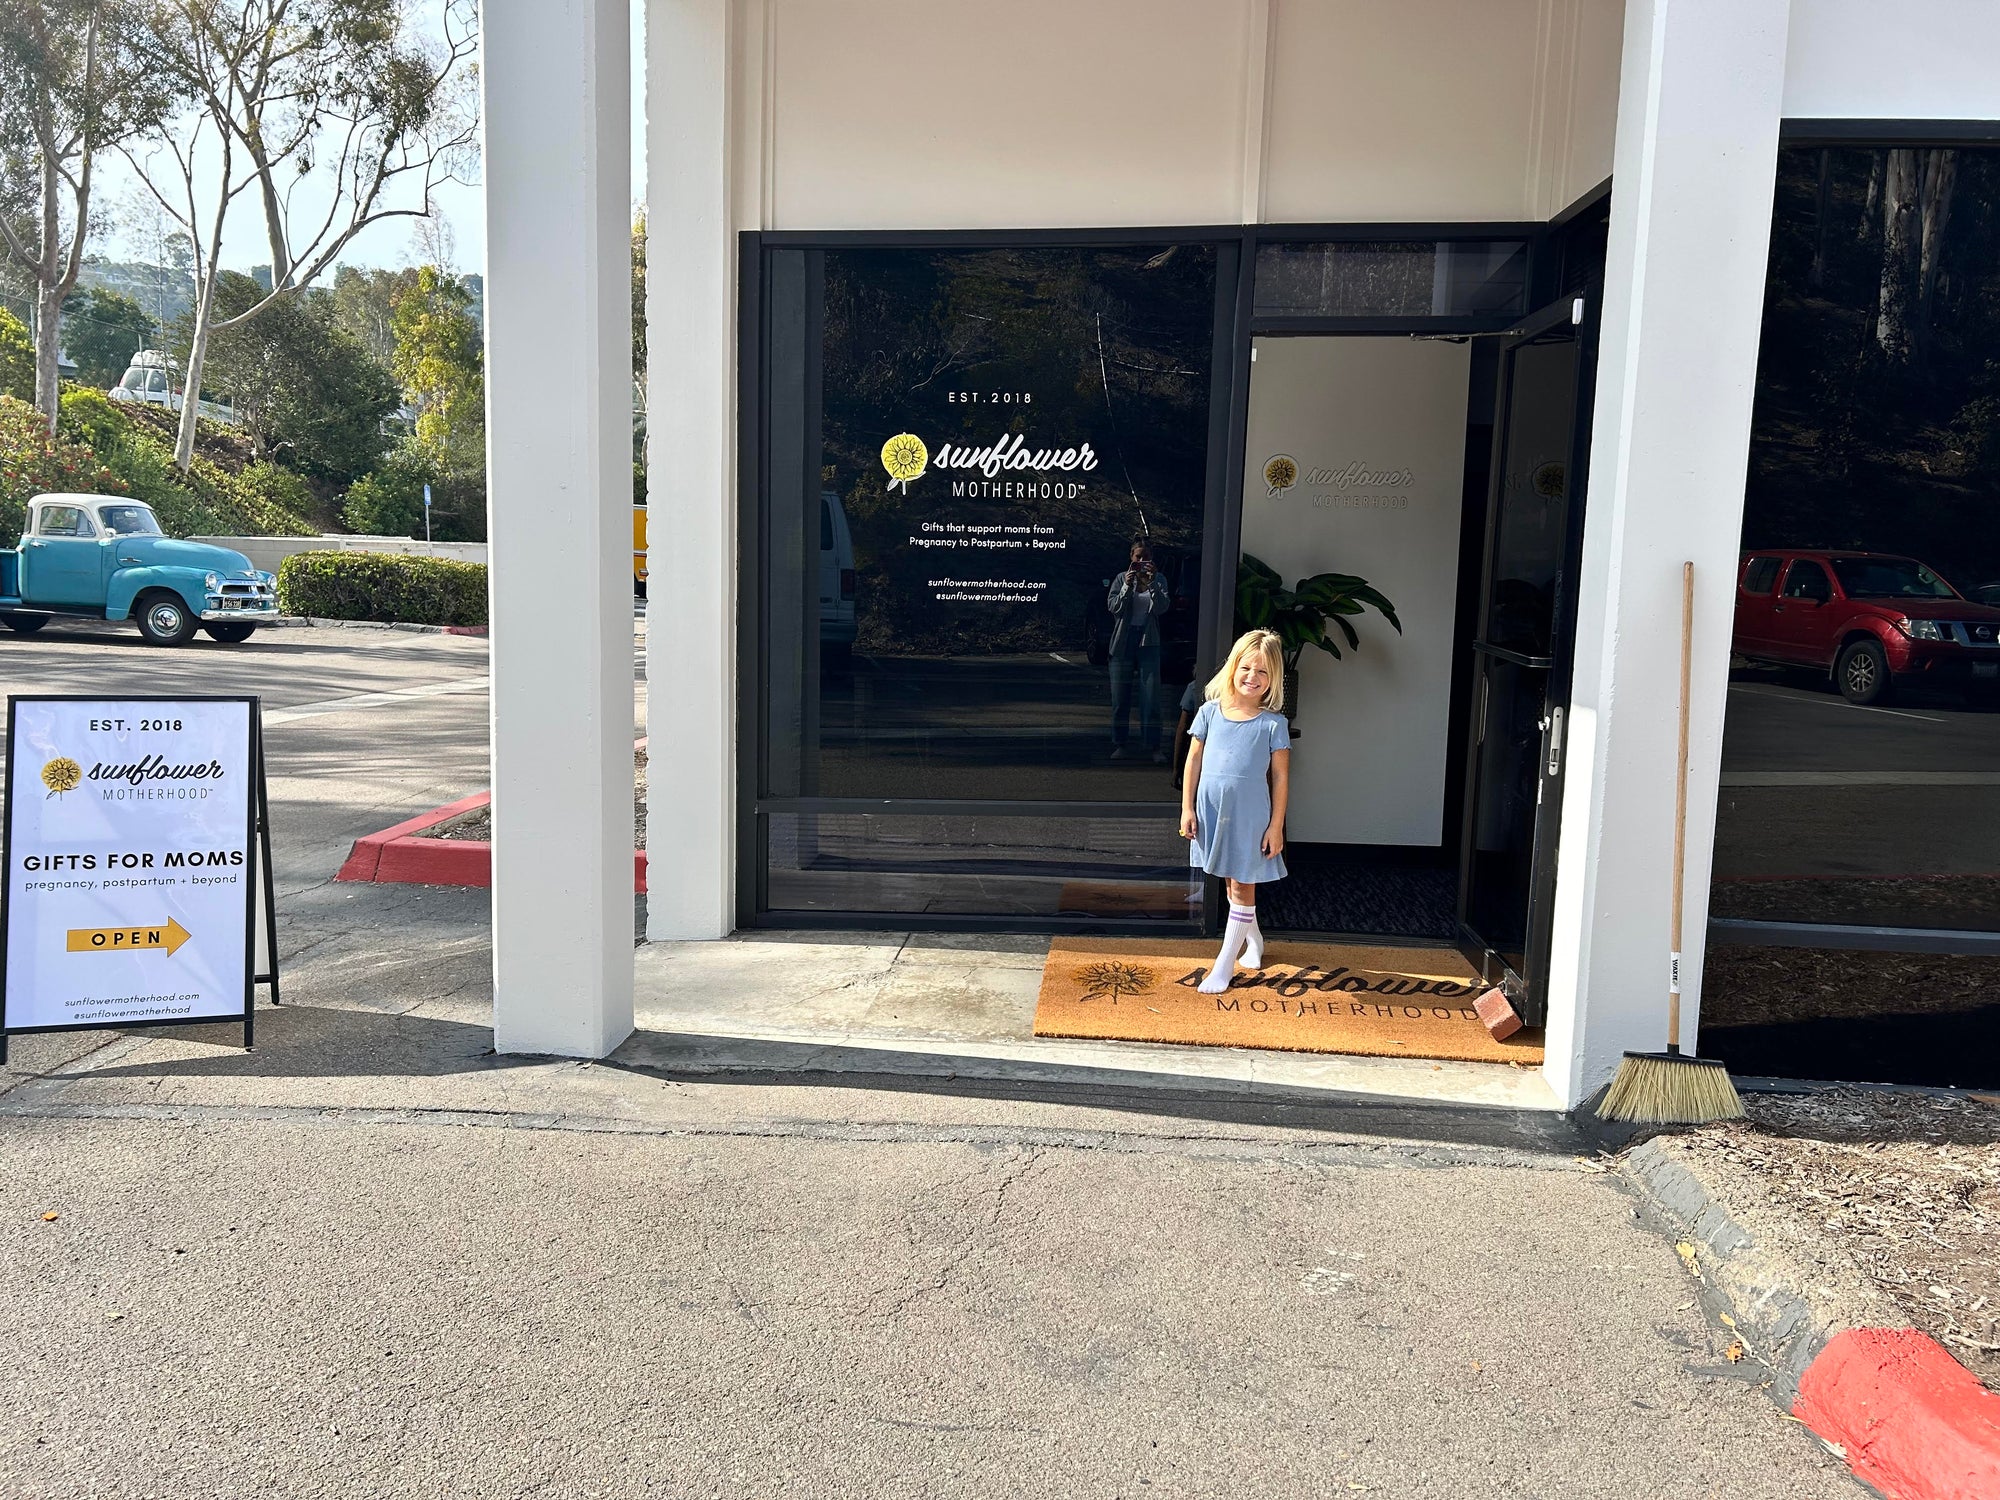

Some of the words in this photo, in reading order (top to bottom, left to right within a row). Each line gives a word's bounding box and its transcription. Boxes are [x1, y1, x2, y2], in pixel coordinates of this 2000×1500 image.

[932, 432, 1098, 478] sunflower
[1304, 460, 1415, 491] sunflower
[1312, 494, 1409, 510] MOTHERHOOD
[921, 522, 944, 532] Gifts
[946, 523, 965, 533] that
[967, 524, 1002, 535] support
[1004, 526, 1031, 534] moms
[1033, 524, 1054, 534] from
[909, 536, 957, 548] Pregnancy
[959, 538, 969, 547] to
[971, 537, 1023, 549] Postpartum
[1032, 539, 1066, 550] Beyond
[927, 577, 1047, 590] sunflowermotherhood.com
[935, 591, 1039, 603] @sunflowermotherhood
[89, 719, 132, 732] EST.
[139, 719, 183, 731] 2018
[87, 754, 225, 786] sunflower
[23, 854, 97, 871] GIFTS
[107, 853, 154, 869] FOR
[164, 850, 244, 867] MOMS
[25, 878, 98, 892] pregnancy,
[102, 876, 176, 890] postpartum
[191, 873, 237, 887] beyond
[91, 930, 161, 946] OPEN
[64, 992, 200, 1007] sunflowermotherhood.com
[1217, 998, 1479, 1021] MOTHERHOOD
